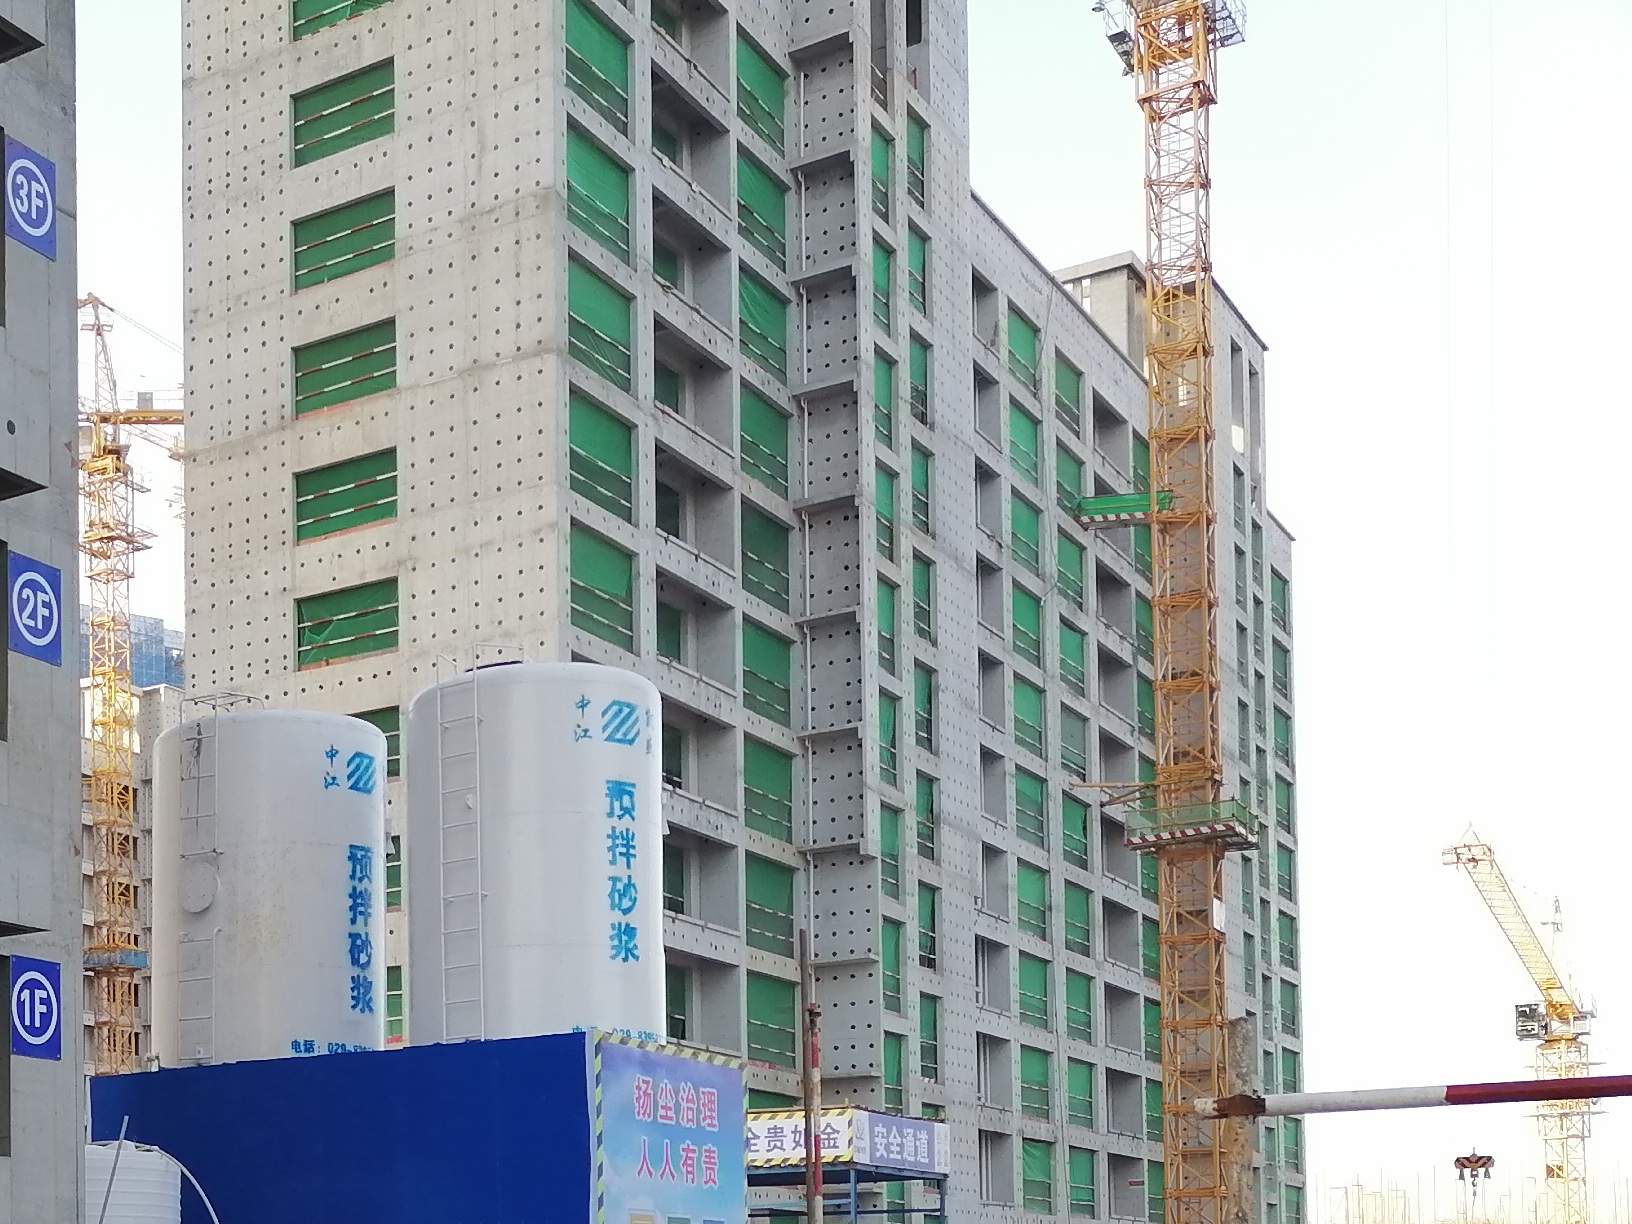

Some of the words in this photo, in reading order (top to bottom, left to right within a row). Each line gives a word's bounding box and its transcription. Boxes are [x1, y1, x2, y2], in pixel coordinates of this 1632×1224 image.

[15, 173, 44, 220] 3F
[21, 587, 50, 630] 2F
[605, 780, 639, 963] 预拌砂浆
[347, 843, 375, 1016] 预拌砂浆
[20, 988, 49, 1028] 1F
[634, 1074, 719, 1132] 扬尘治理
[636, 1137, 719, 1188] 人人有责
[874, 1123, 930, 1164] 安全通道
